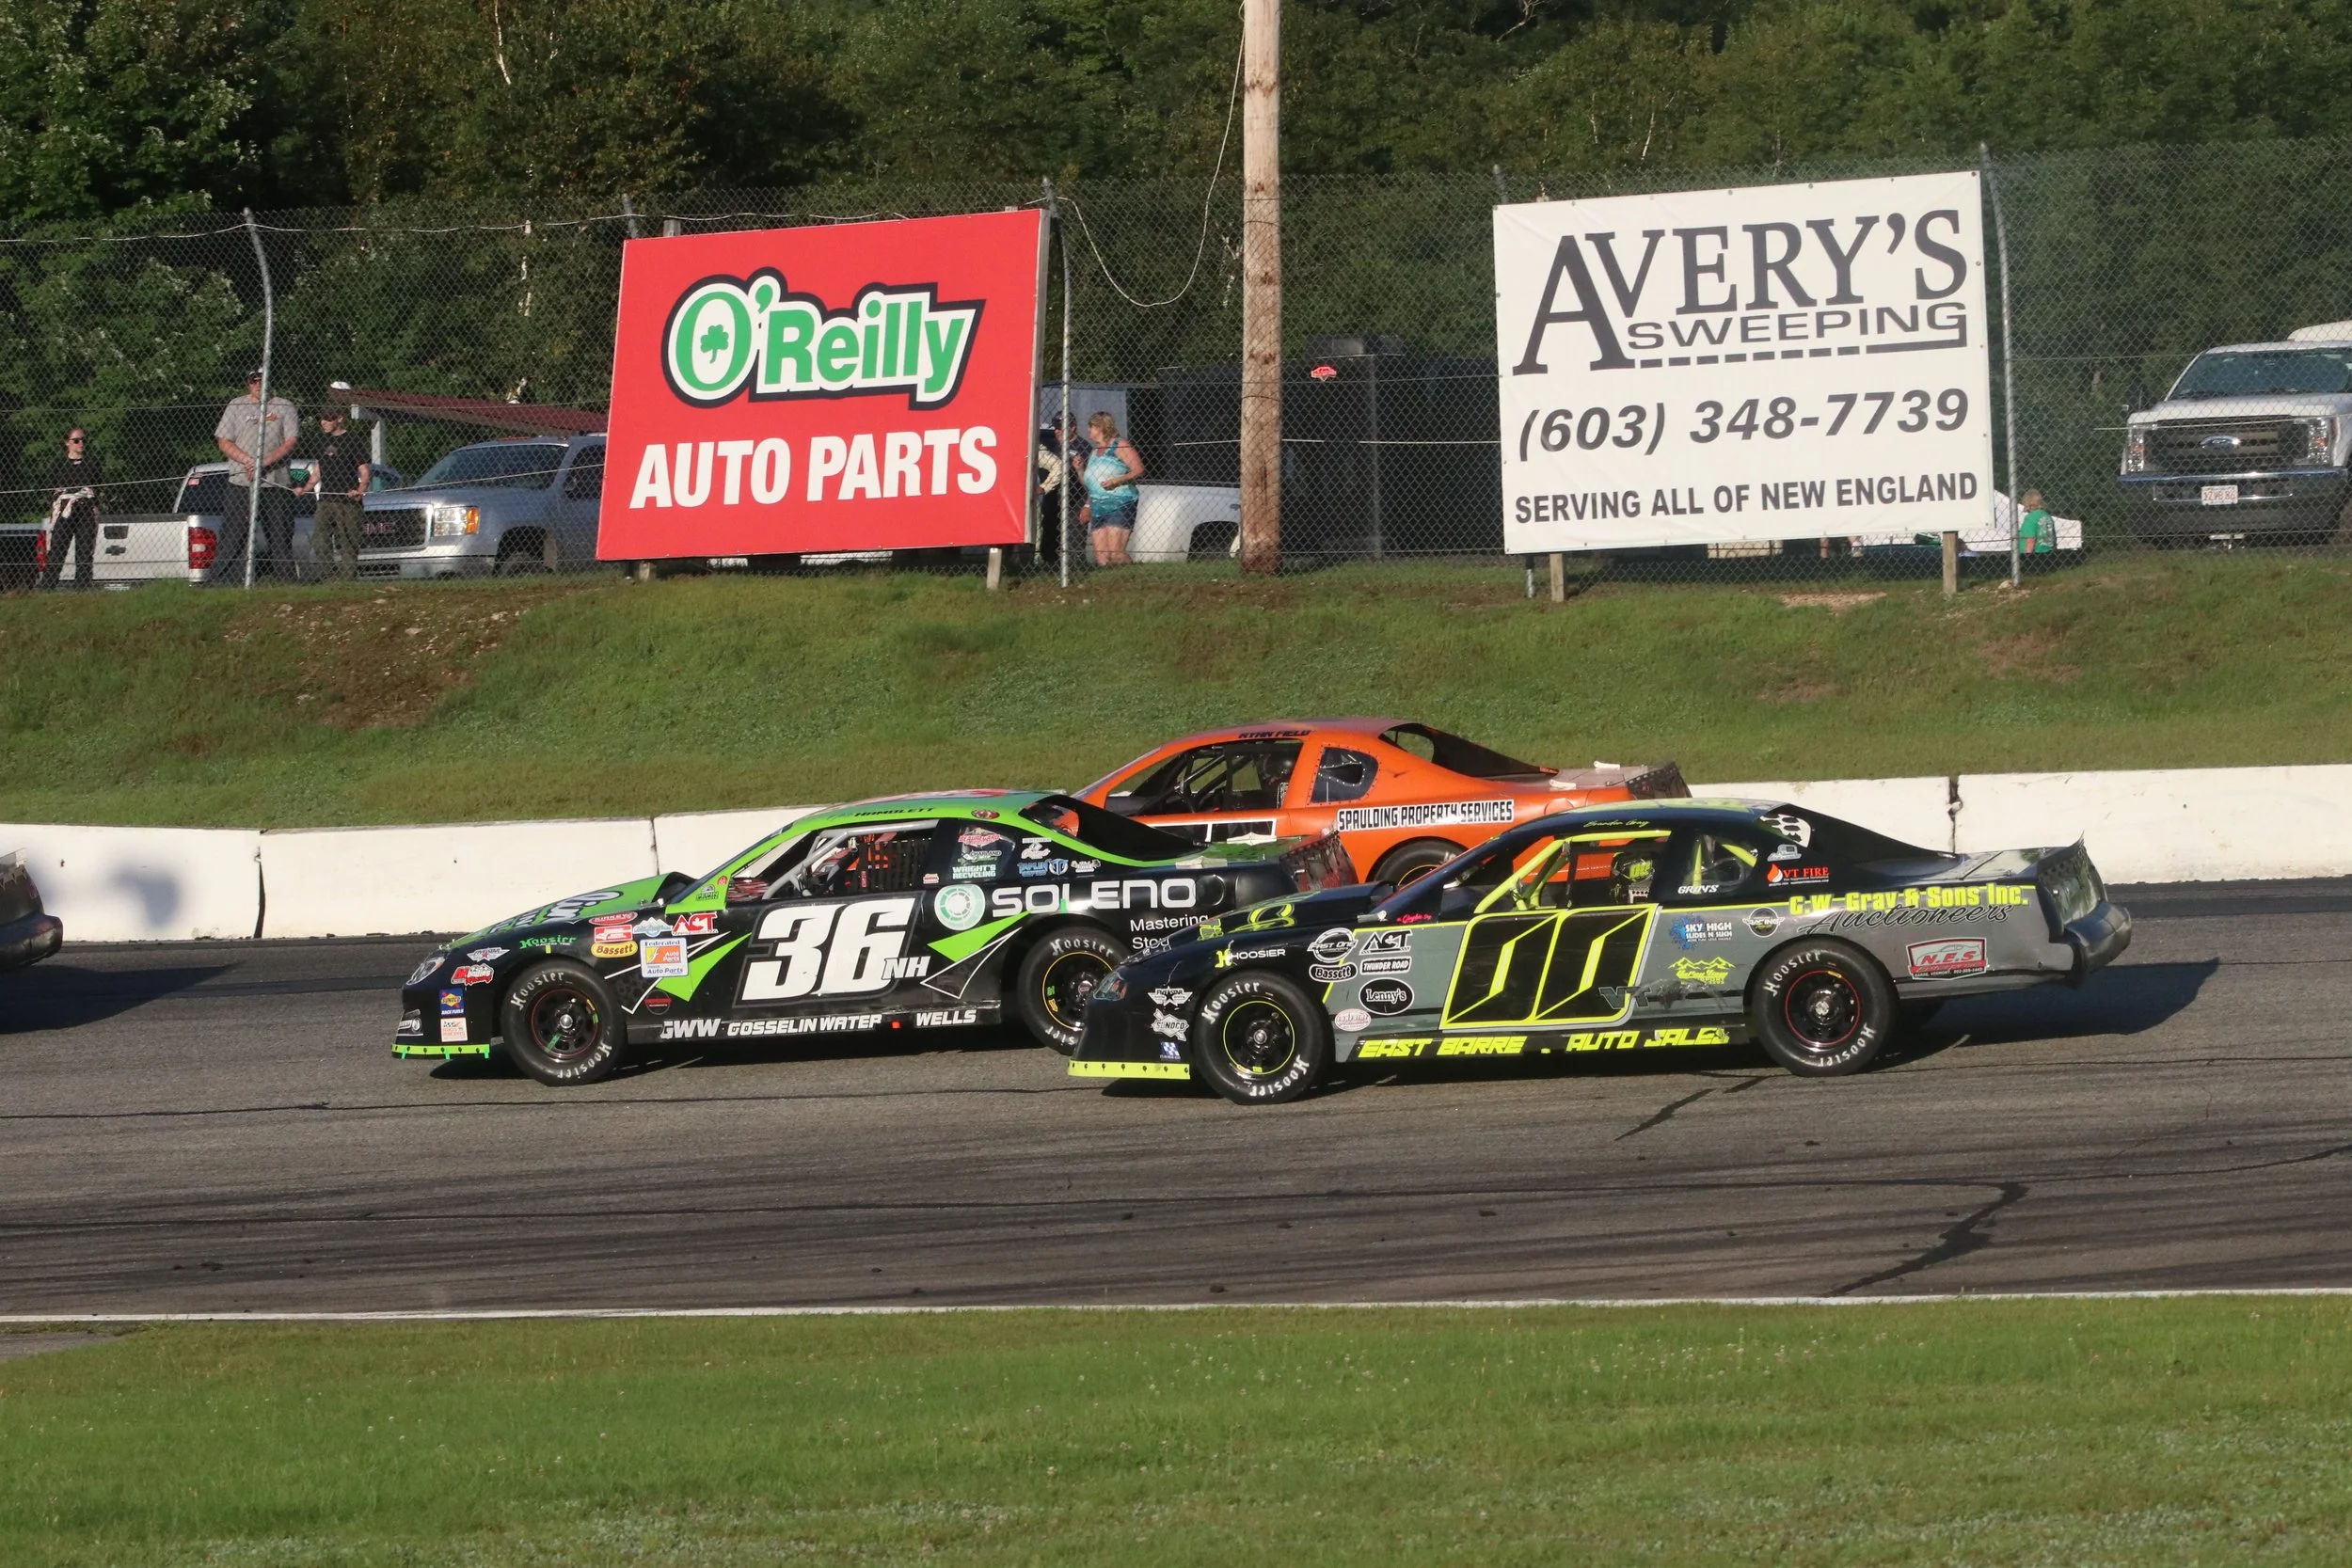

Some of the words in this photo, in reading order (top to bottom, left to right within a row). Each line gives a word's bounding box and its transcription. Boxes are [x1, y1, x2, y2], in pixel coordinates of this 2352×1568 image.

[1513, 209, 1967, 375] AVERY'S
[668, 276, 976, 402] O'Reilly
[1629, 302, 1967, 350] SWEEPING
[1519, 403, 1665, 462] (603)
[1690, 388, 1968, 444] 348-7739
[629, 437, 790, 509] AUTO
[807, 426, 997, 501] PARTS
[1515, 490, 1641, 524] SERVING
[1651, 487, 1704, 516] ALL
[1713, 484, 1750, 513] OF
[1761, 481, 1825, 510] NEW
[1836, 472, 1977, 506] ENGLAND
[1338, 807, 1398, 832] SPAULDING
[1401, 803, 1457, 826] PROPERTY
[1460, 800, 1514, 822] SERVICES
[952, 871, 996, 879] RECYCLING
[1783, 869, 1799, 879] VT
[1803, 867, 1829, 878] FIRE
[992, 879, 1196, 917] SOLENO
[1903, 888, 1921, 909] &
[1925, 885, 1980, 909] Sons
[1985, 882, 2029, 906] Inc.
[672, 911, 718, 934] ACT
[1685, 923, 1703, 932] SKY
[1706, 922, 1732, 931] HIGH
[1797, 903, 2014, 936] Auctioneers
[519, 934, 577, 950] Hoosier
[741, 897, 916, 1001] 36
[1050, 938, 1114, 957] Hoosier
[1360, 929, 1413, 951] ACT
[1715, 930, 1732, 939] SUCH
[596, 943, 634, 956] Bassett
[1231, 948, 1286, 960] HOOSIER
[882, 956, 931, 980] NH
[1315, 965, 1352, 979] Bassett
[1363, 959, 1391, 971] THUNDER
[1391, 958, 1409, 970] ROAD
[1763, 950, 1821, 997] Hoosier
[510, 971, 564, 1011] Hoosier
[1201, 981, 1260, 1024] Hoosier
[1366, 988, 1406, 1005] Lenny's
[727, 1017, 818, 1037] GOSSELIN
[818, 1014, 882, 1032] WATER
[916, 1009, 977, 1027] WELLS
[1156, 1022, 1185, 1030] SUNOCO
[1358, 1037, 1433, 1058] EAST
[1437, 1036, 1528, 1056] BARRE
[1565, 1030, 1641, 1052] AUTO
[1644, 1027, 1730, 1048] SALES
[1818, 1022, 1877, 1067] Hoosier
[557, 1040, 612, 1079] Hoosier
[1249, 1054, 1310, 1098] Hoosier
